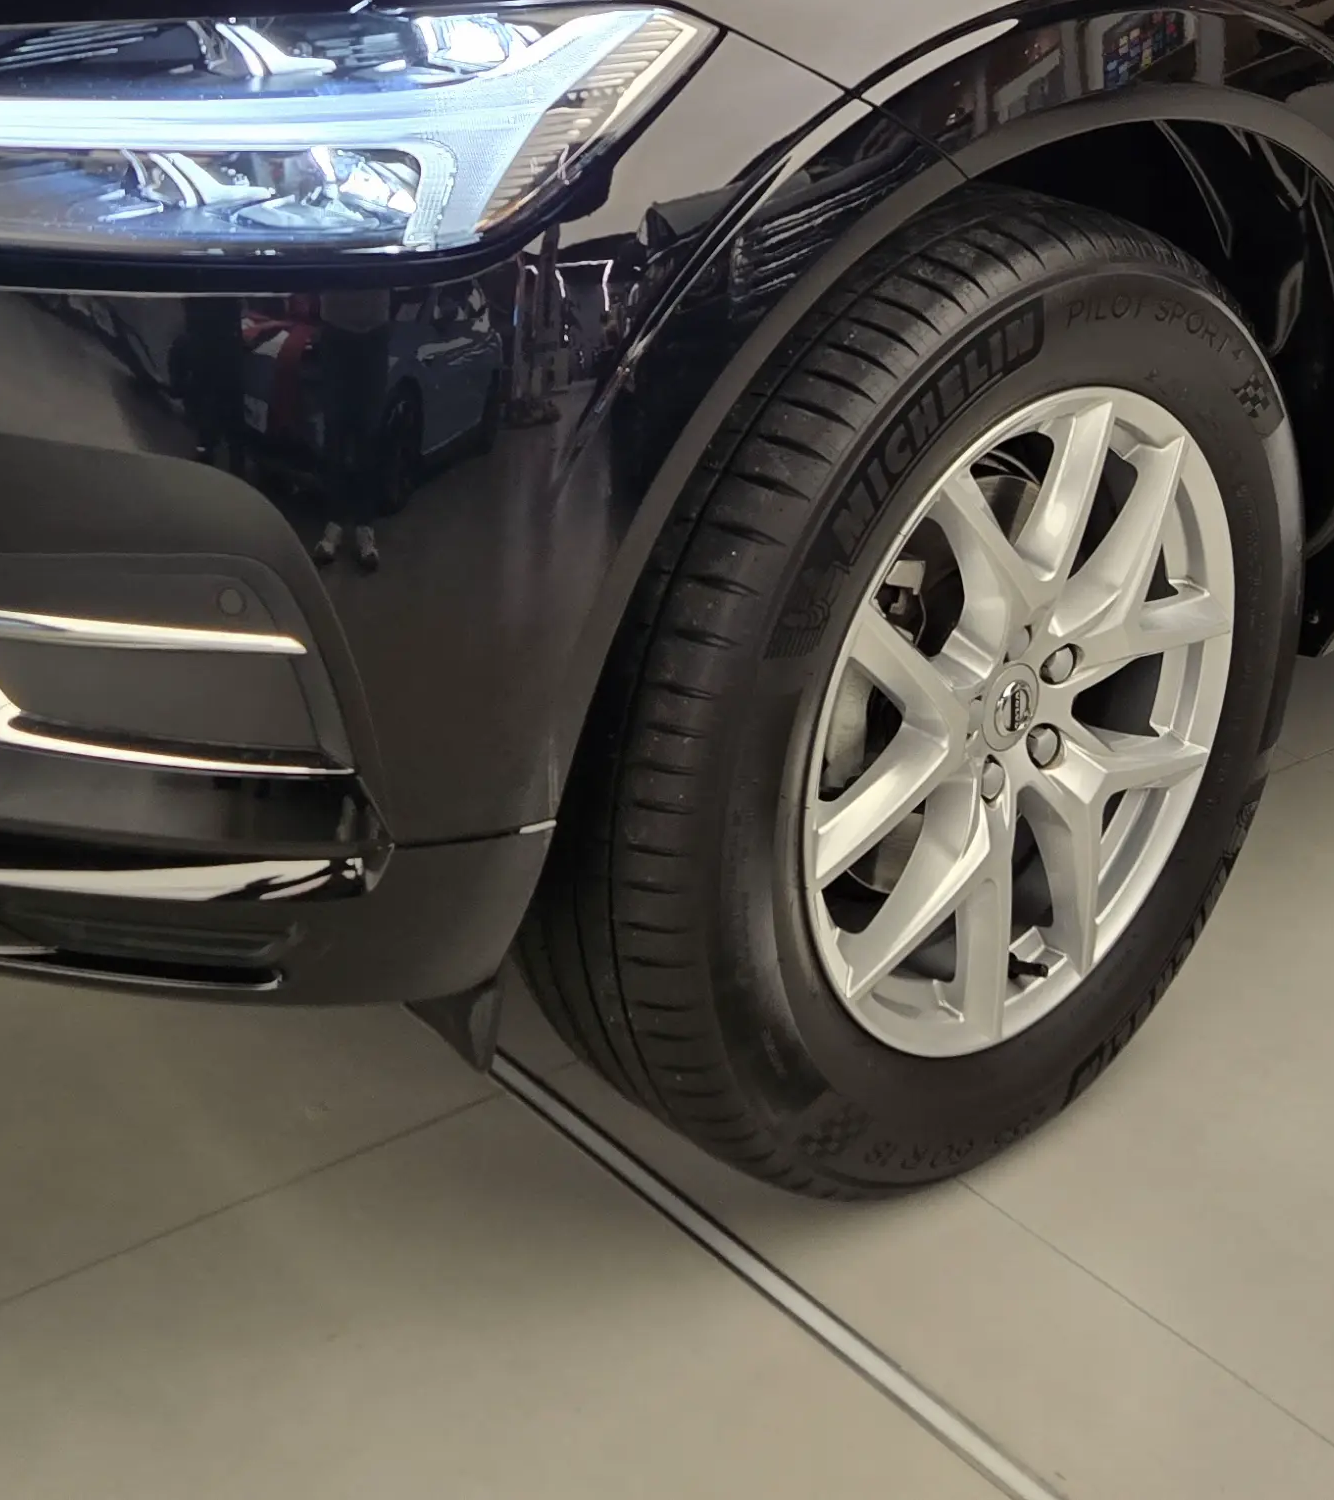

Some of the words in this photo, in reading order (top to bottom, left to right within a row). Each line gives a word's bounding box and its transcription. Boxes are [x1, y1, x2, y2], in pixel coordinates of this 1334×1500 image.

[1066, 296, 1146, 328] PILOT
[1154, 300, 1233, 353] SPORT
[831, 307, 1037, 561] MICHELIN
